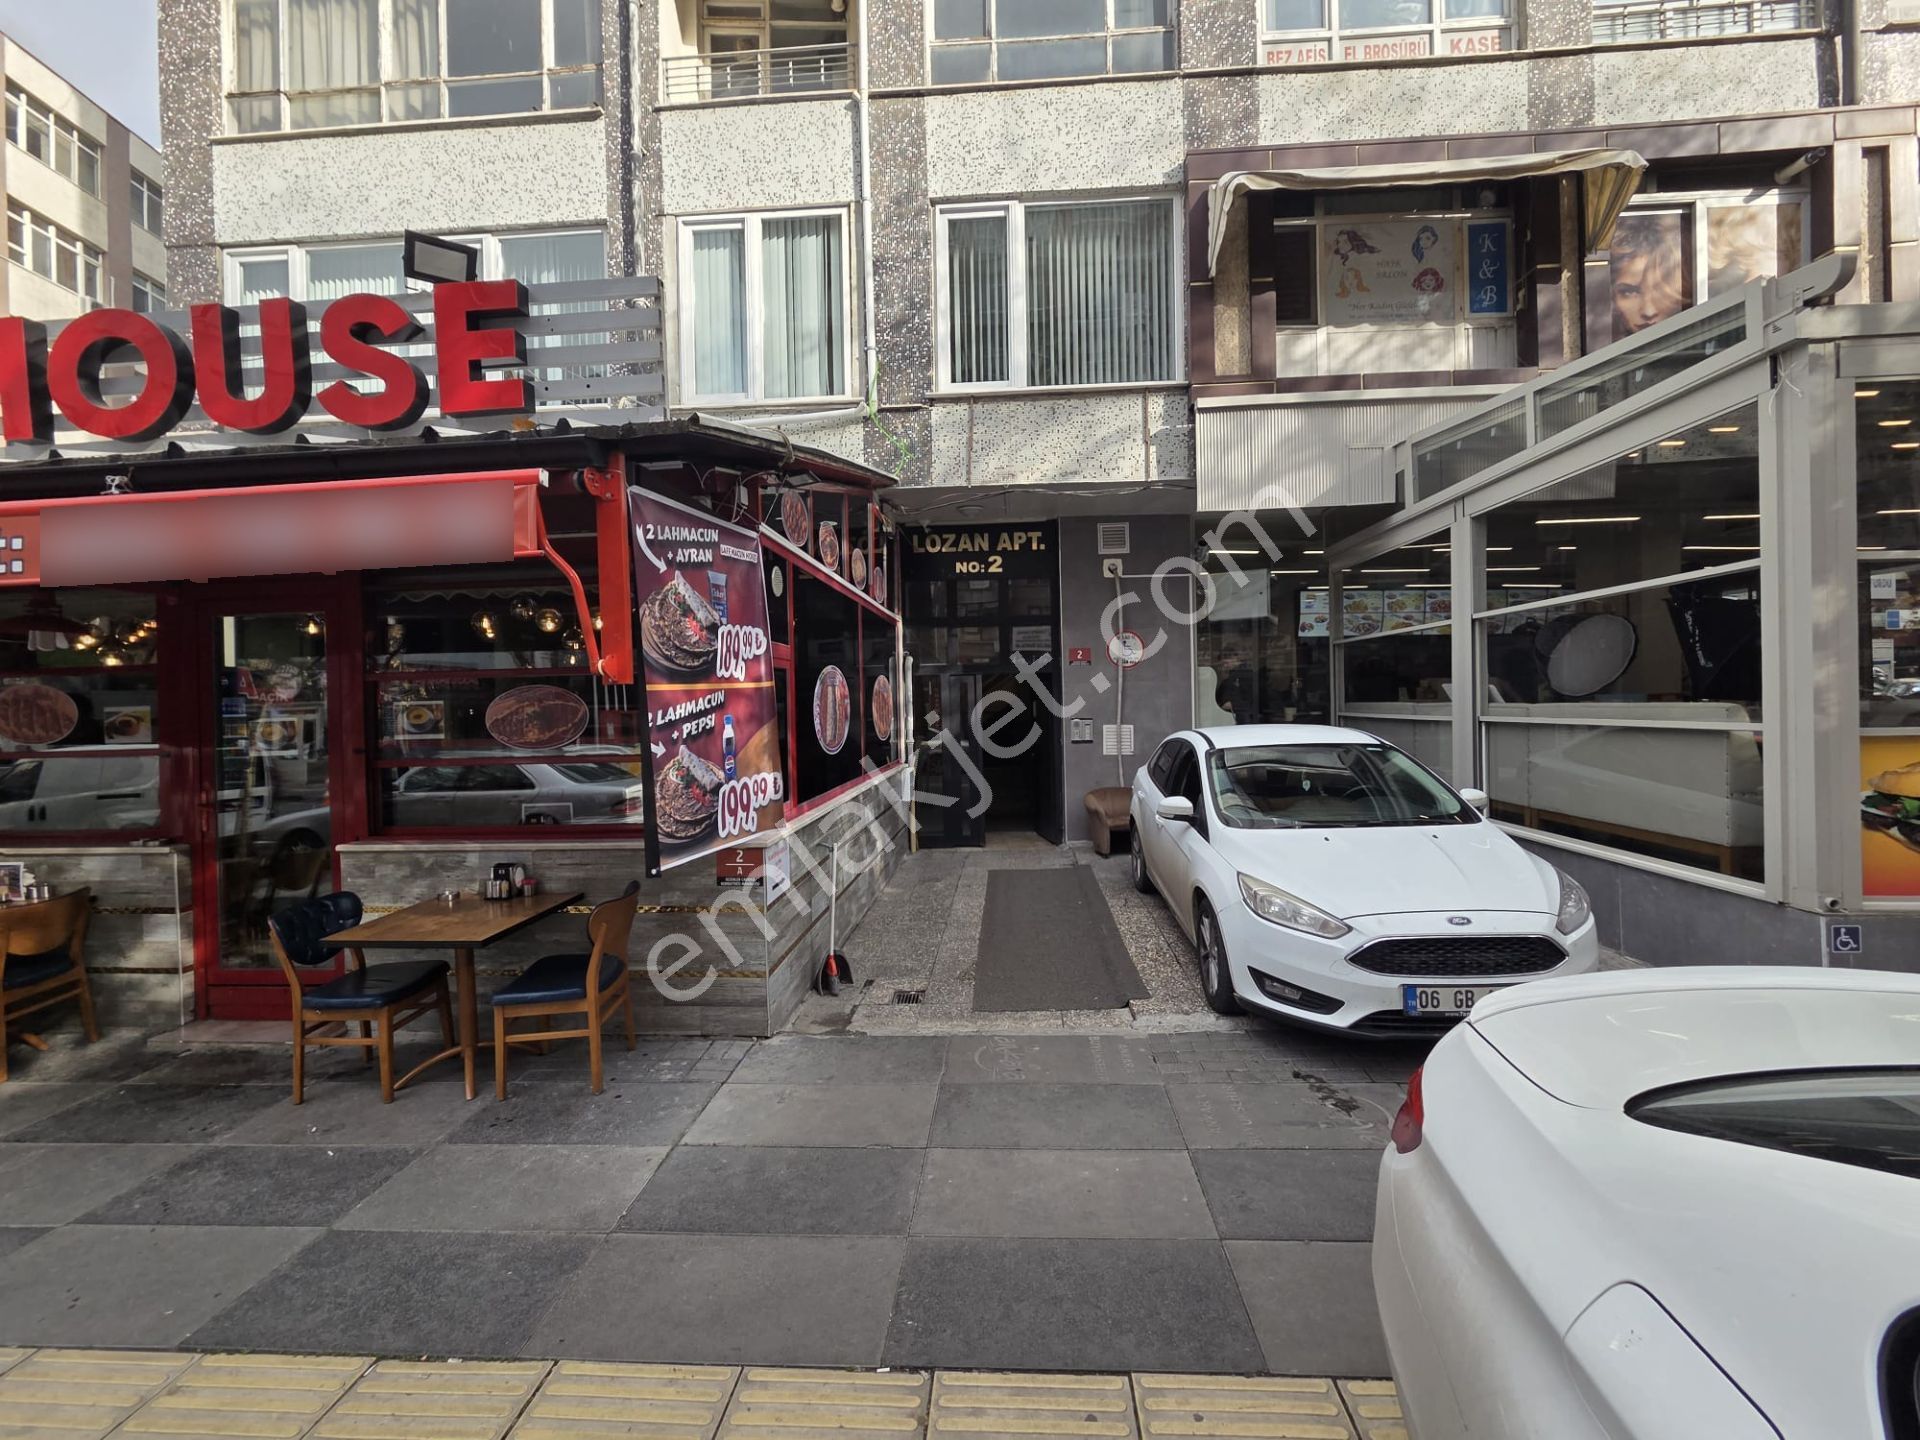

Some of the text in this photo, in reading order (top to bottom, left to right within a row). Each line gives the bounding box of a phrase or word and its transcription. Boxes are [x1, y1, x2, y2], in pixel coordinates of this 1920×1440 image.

[1479, 233, 1499, 306] K & B
[645, 523, 719, 543] 2 LAHMACUN
[912, 531, 1046, 554] LOZAN APT.
[676, 547, 713, 563] AYRAN
[1076, 650, 1083, 659] 2
[656, 689, 725, 726] LAHMACUN
[682, 713, 716, 739] PEPSI
[735, 849, 744, 863] 2
[736, 866, 743, 876] A
[1418, 989, 1475, 1010] 06 GB
